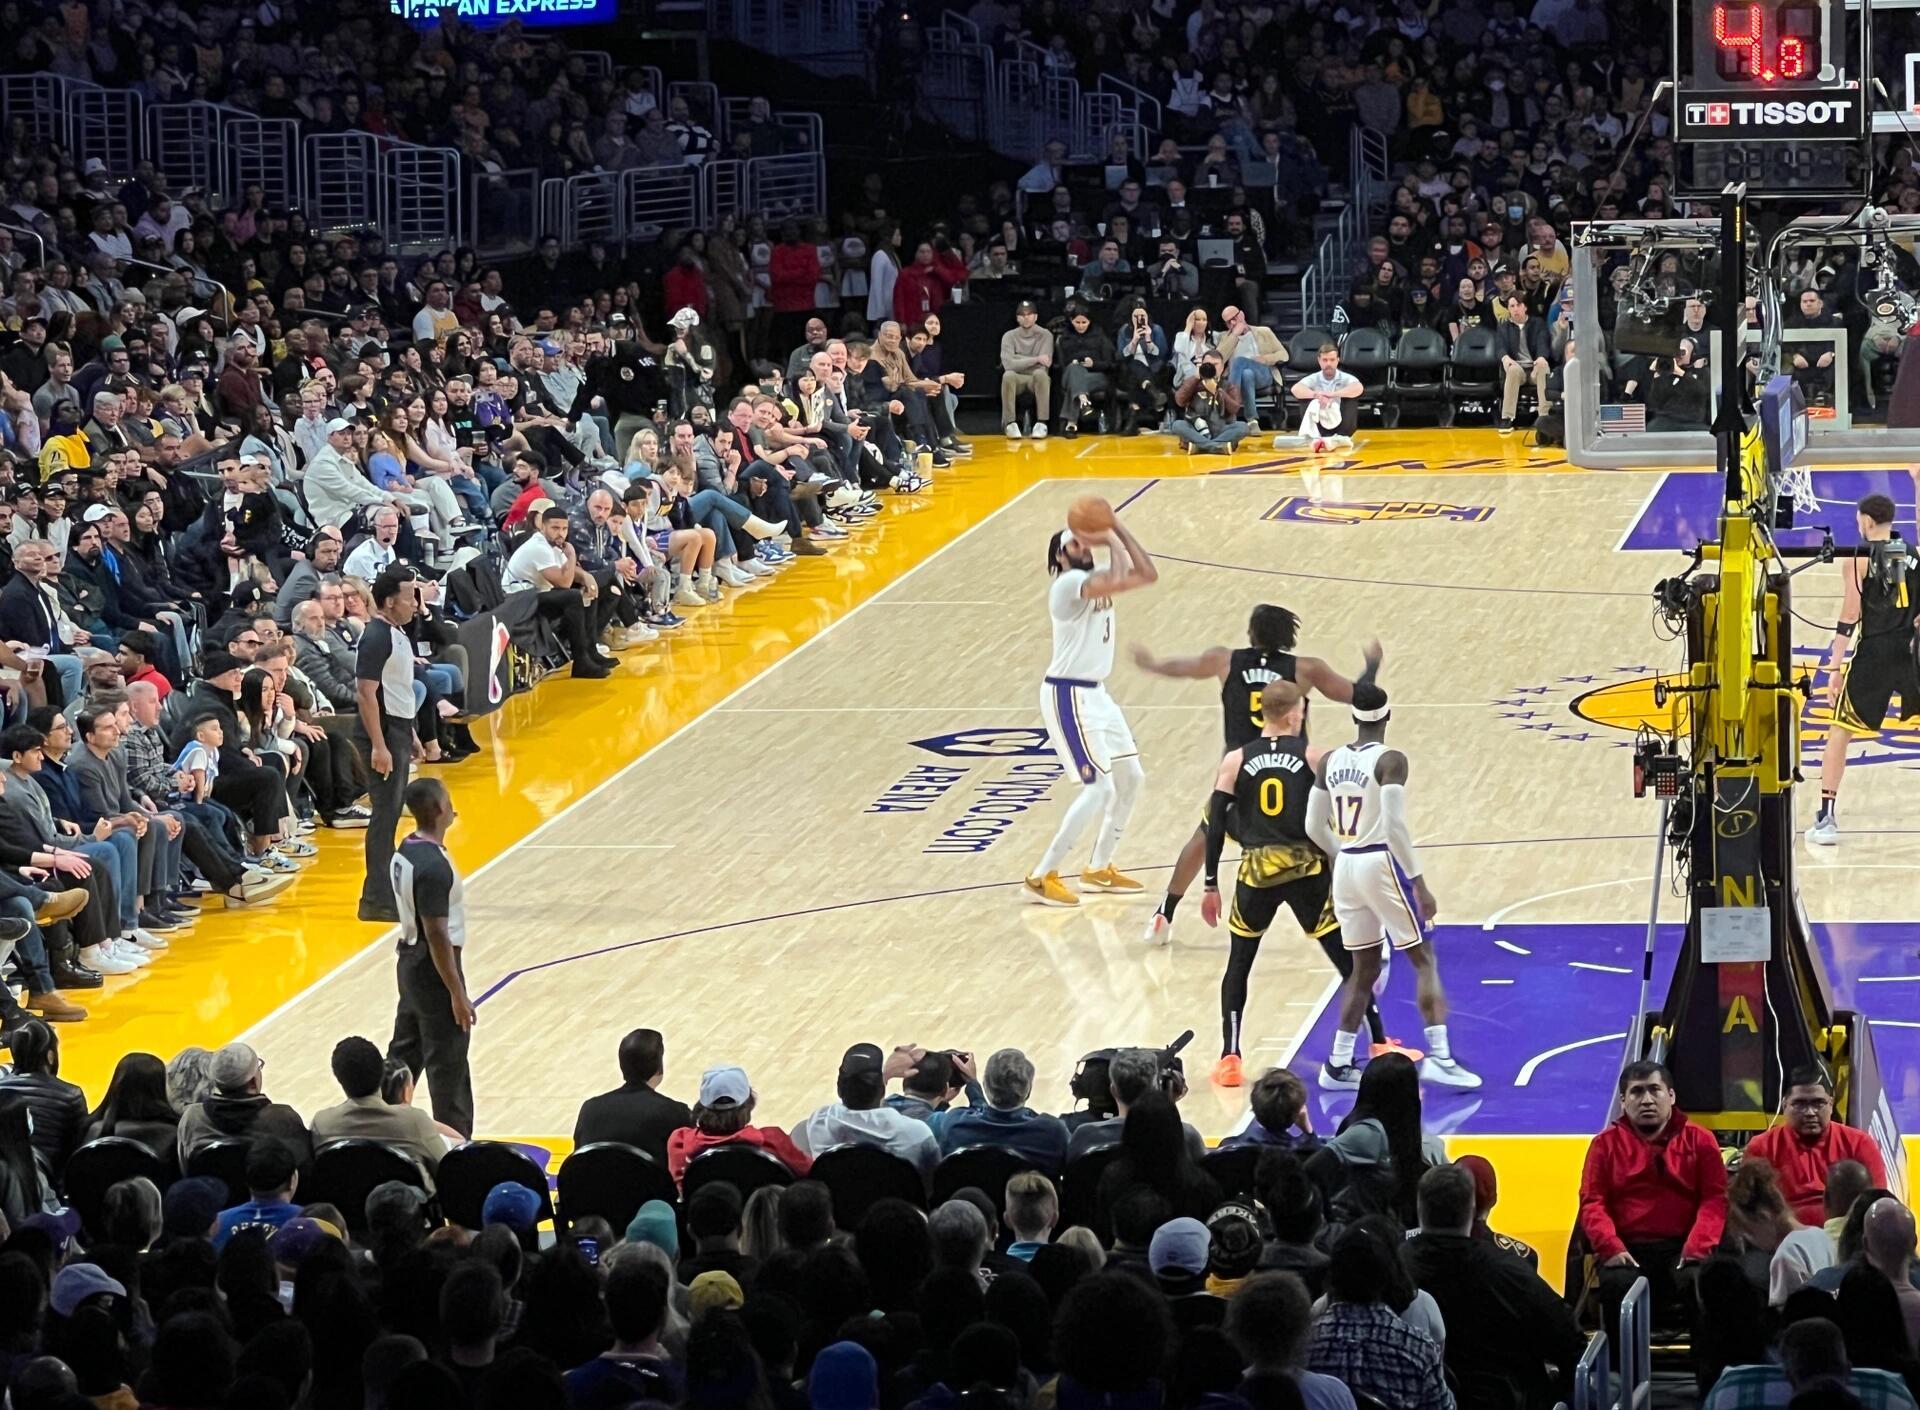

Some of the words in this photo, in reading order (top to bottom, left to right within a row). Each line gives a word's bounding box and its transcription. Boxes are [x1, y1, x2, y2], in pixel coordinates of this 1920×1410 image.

[1715, 6, 1803, 82] 4.8
[1731, 101, 1852, 125] TISSOT
[863, 764, 971, 814] ARENA
[922, 763, 1065, 853] crypto.com
[1260, 777, 1284, 817] 0
[1335, 796, 1363, 836] 17
